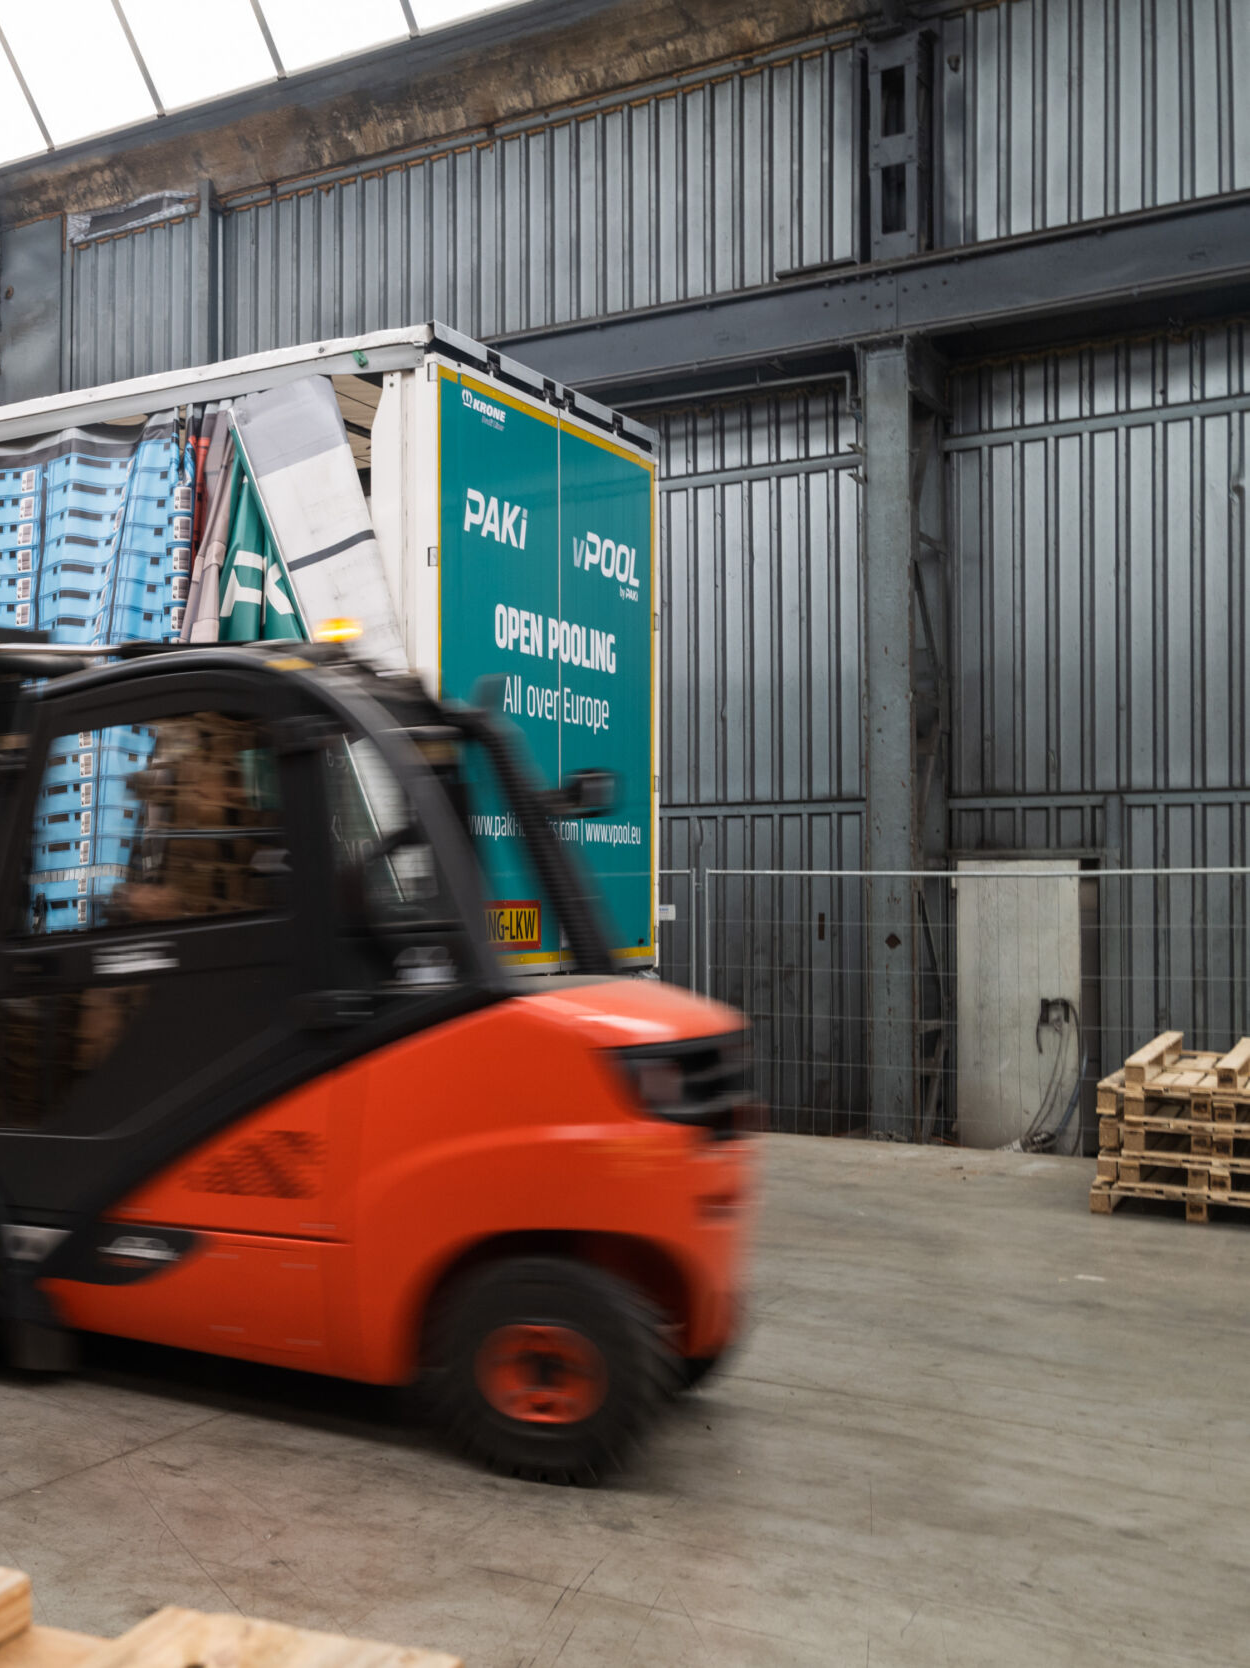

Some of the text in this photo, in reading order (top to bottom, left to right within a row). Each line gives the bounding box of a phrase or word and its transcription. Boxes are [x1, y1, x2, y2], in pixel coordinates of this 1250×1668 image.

[473, 398, 506, 423] KRONE
[572, 531, 640, 588] vPOOL
[495, 603, 616, 674] OPEN POOLING
[503, 675, 609, 735] All over Europe
[585, 822, 641, 847] www.vpool.eu
[485, 910, 536, 940] NG-LKW
